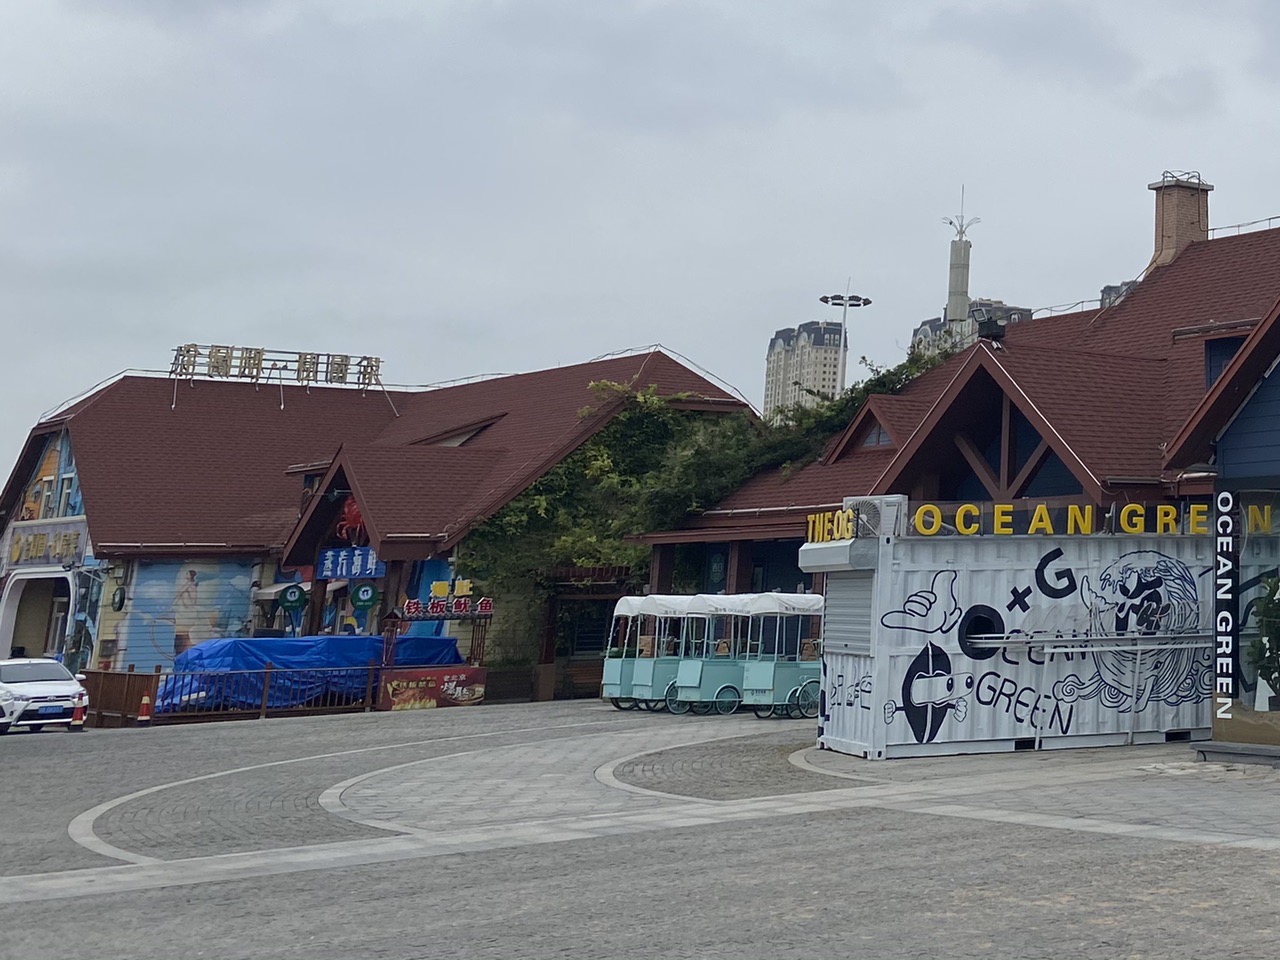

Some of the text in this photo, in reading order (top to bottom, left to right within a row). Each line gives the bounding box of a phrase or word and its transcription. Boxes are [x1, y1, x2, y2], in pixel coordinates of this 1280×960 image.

[915, 503, 1273, 536] OCEAN GREN
[403, 596, 494, 618] 铁板鱿鱼
[1215, 490, 1234, 721] OCEAN GREEN
[975, 670, 1074, 735] GREEN
